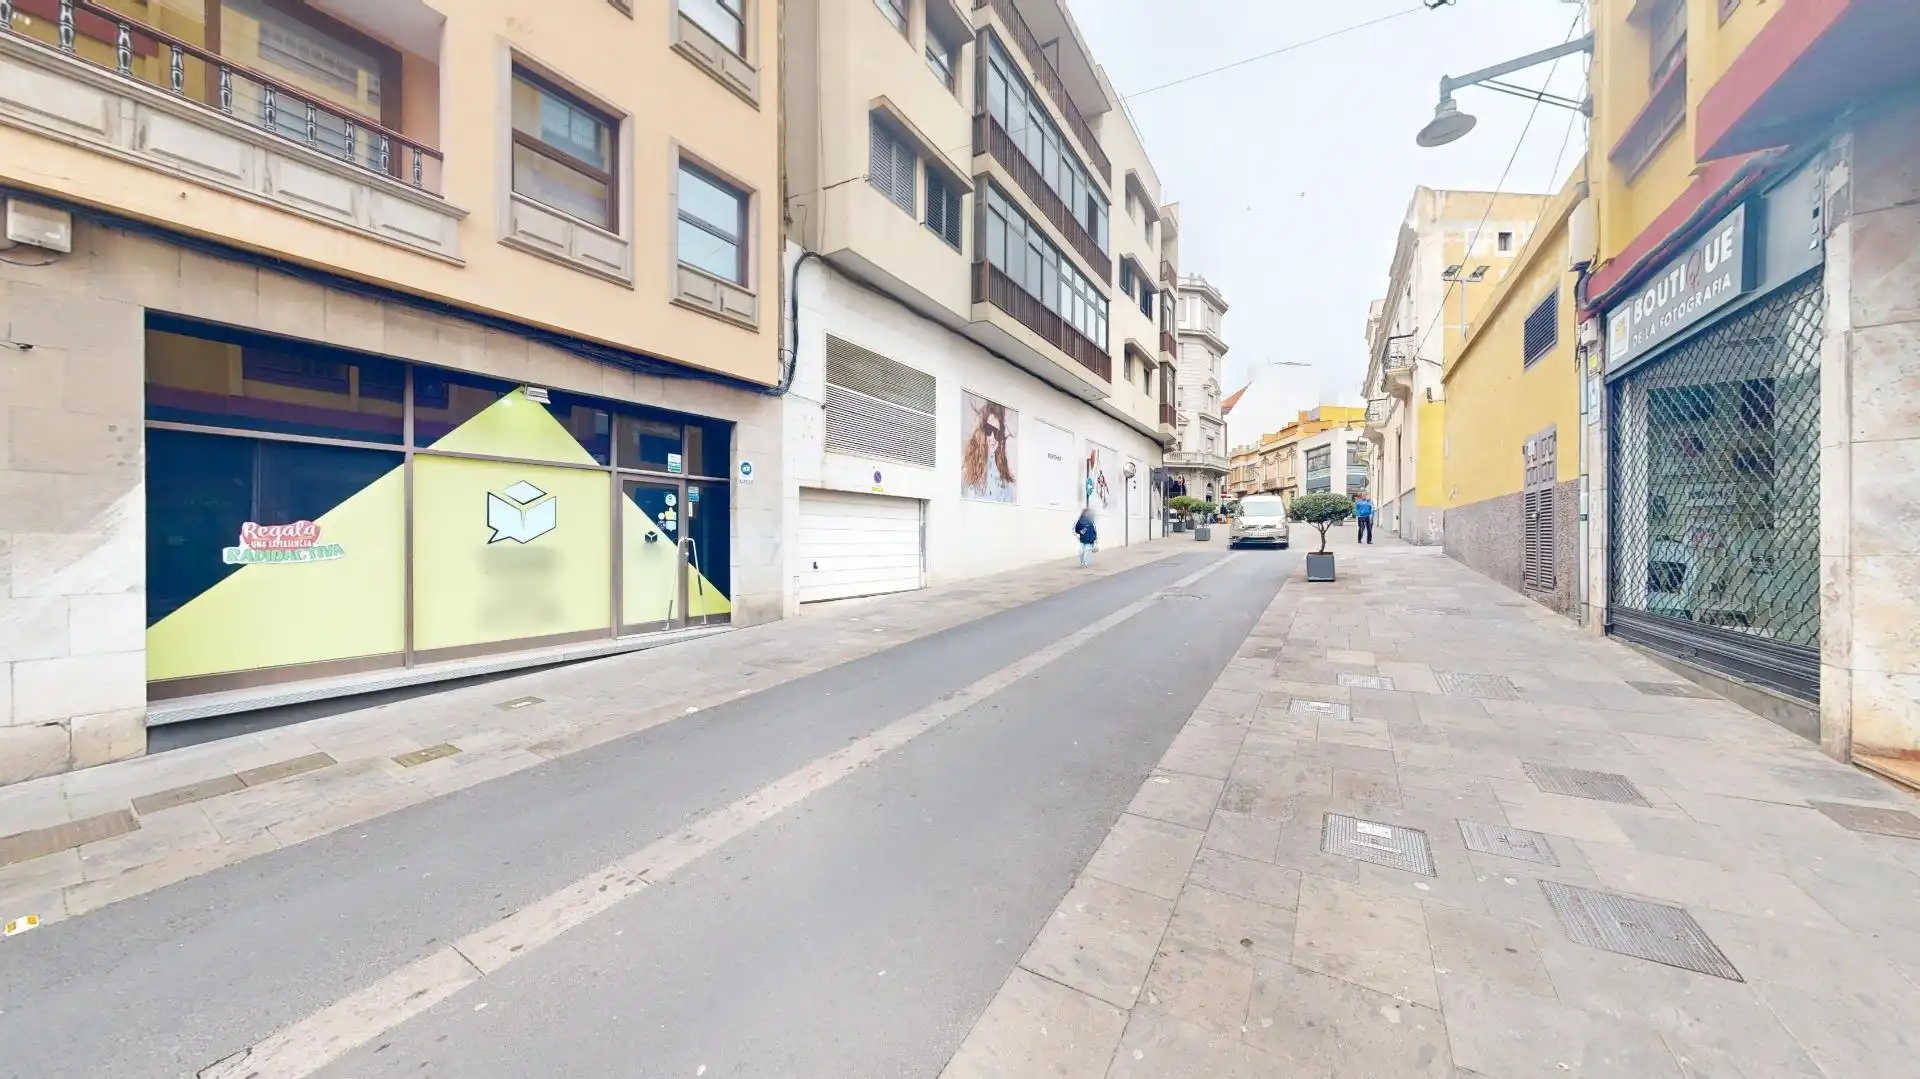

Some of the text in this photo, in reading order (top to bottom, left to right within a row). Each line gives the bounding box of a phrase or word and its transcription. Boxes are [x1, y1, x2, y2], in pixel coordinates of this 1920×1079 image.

[1633, 225, 1735, 325] BOUTIQUE
[1632, 272, 1732, 348] DE LA FOTOGRAFIA
[244, 521, 317, 541] Regala
[251, 540, 266, 548] UNA
